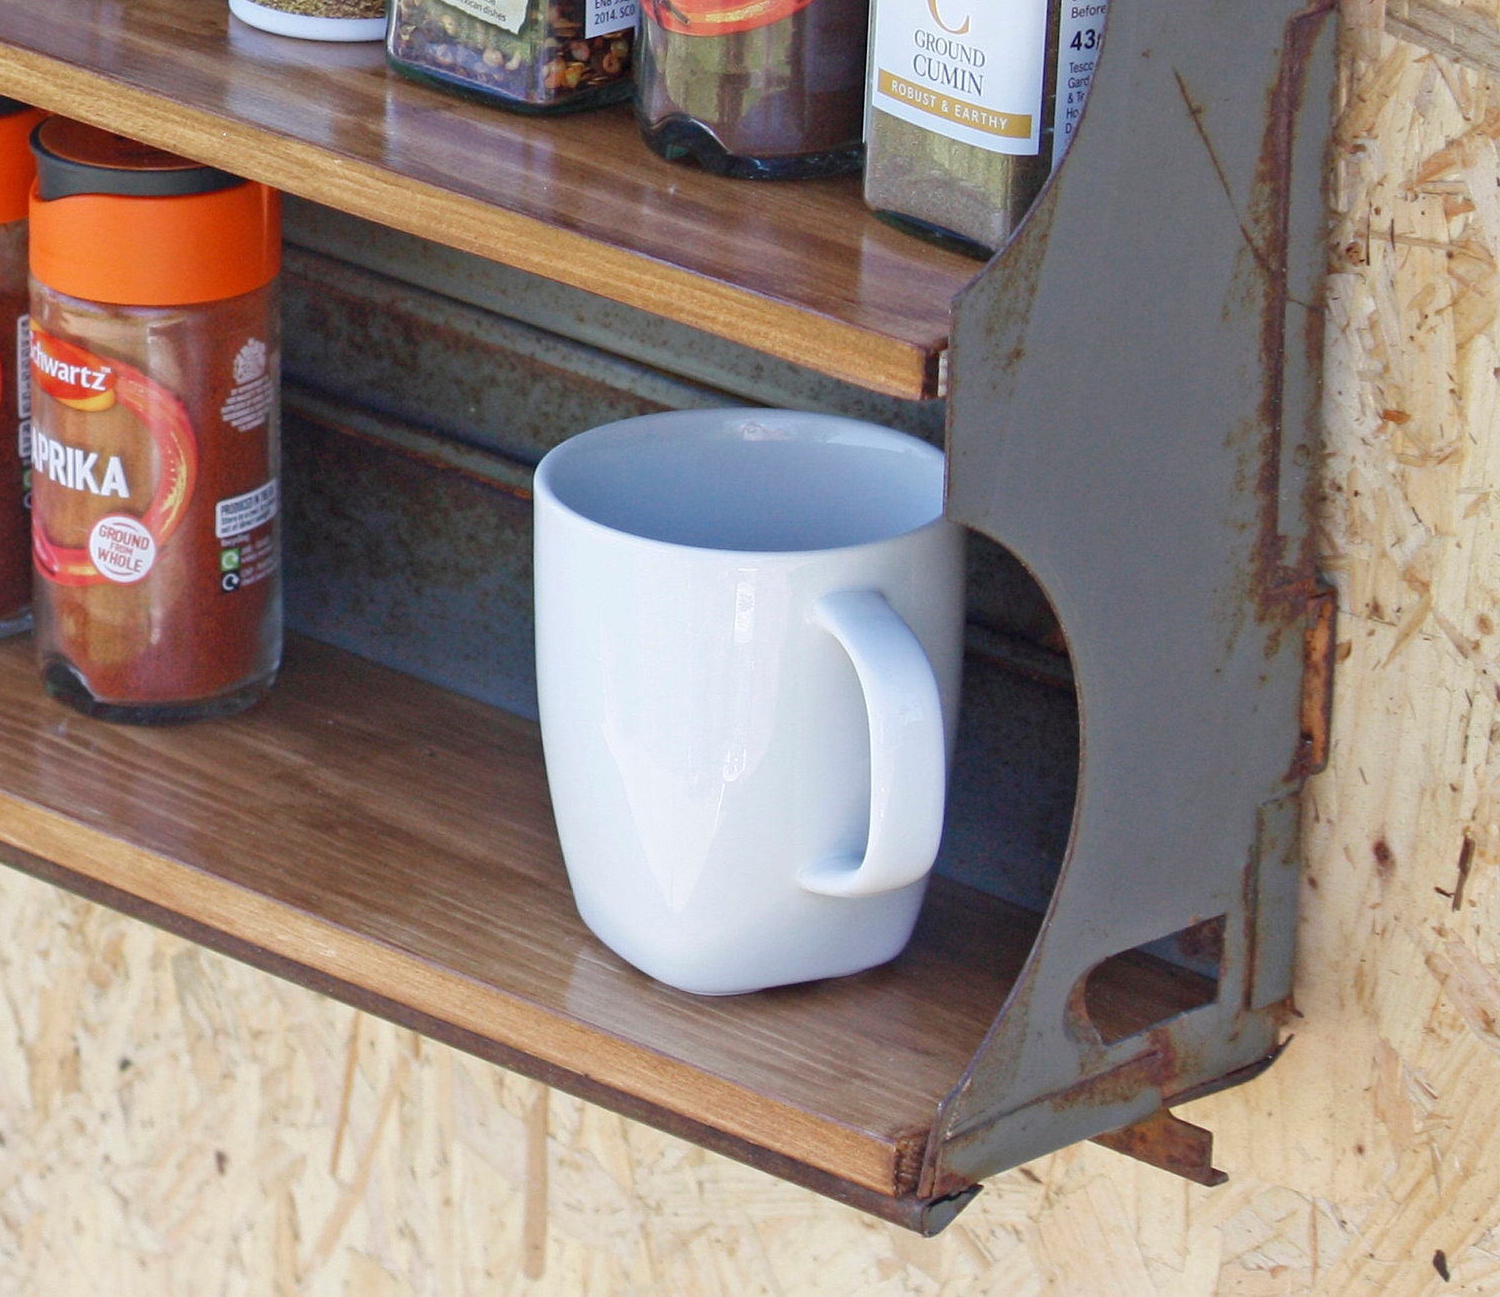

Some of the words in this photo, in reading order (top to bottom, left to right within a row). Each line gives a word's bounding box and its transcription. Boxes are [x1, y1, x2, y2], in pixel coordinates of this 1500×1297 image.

[483, 2, 507, 22] dishes
[914, 29, 986, 69] GROUND
[913, 53, 985, 97] CUMIN
[891, 79, 937, 108] ROBUST
[940, 100, 949, 113] &
[954, 104, 1010, 130] EARTHY
[98, 523, 150, 550] GROUND
[109, 541, 134, 556] FROM
[97, 547, 143, 573] WHOLE
